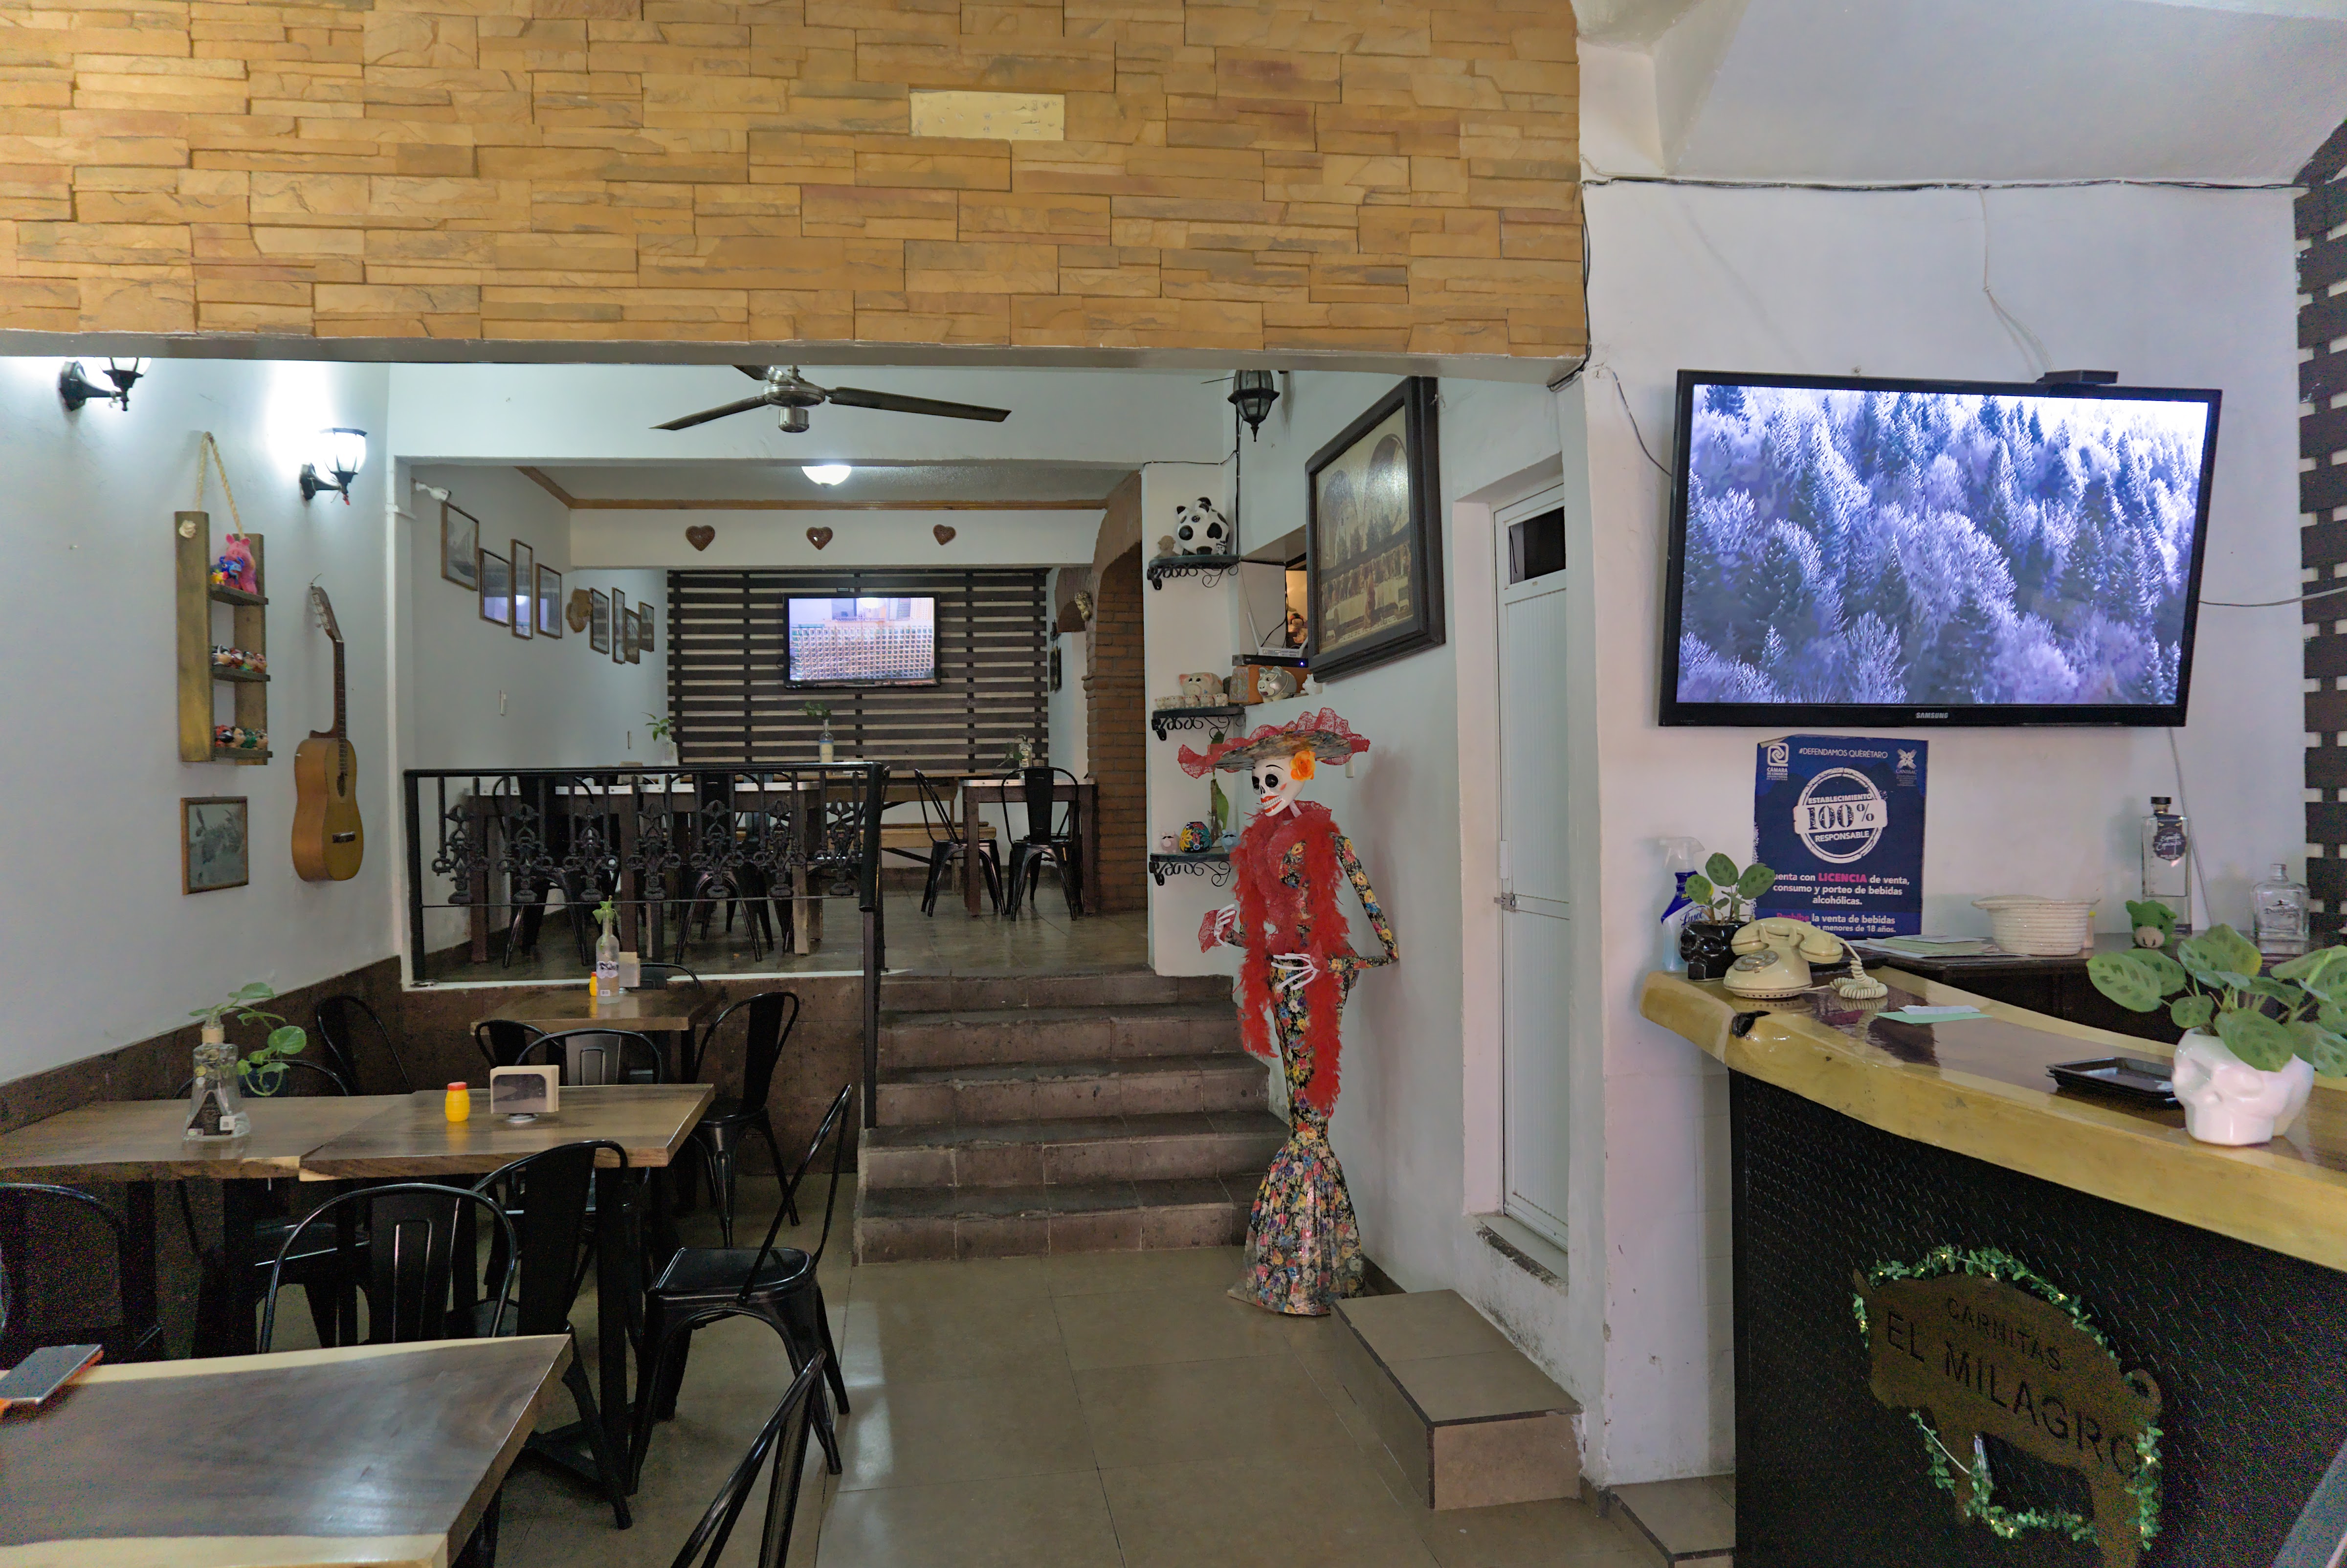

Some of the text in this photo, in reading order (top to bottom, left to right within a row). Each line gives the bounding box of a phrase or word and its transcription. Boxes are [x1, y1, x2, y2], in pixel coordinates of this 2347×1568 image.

[1798, 748, 1848, 757] #DEFENDAMOS
[1808, 793, 1872, 804] ESTABLECIMIENTO
[1807, 803, 1875, 830] 100%
[1815, 831, 1870, 842] RESPONSABLE
[1818, 873, 1868, 883] LICENCIA
[1869, 874, 1881, 883] de
[1883, 877, 1910, 885] venta,
[1814, 886, 1820, 895] y
[1822, 885, 1852, 895] porteo
[1855, 885, 1866, 894] de
[1868, 886, 1903, 895] bebidas
[1812, 895, 1862, 905] alcohólicas.
[1812, 913, 1819, 922] la
[1822, 915, 1846, 923] venta
[1848, 913, 1860, 923] de
[1861, 914, 1896, 924] bebidas
[1878, 925, 1897, 933] años.
[1887, 1310, 1925, 1363] EL
[1948, 1297, 2061, 1371] CARNITAS
